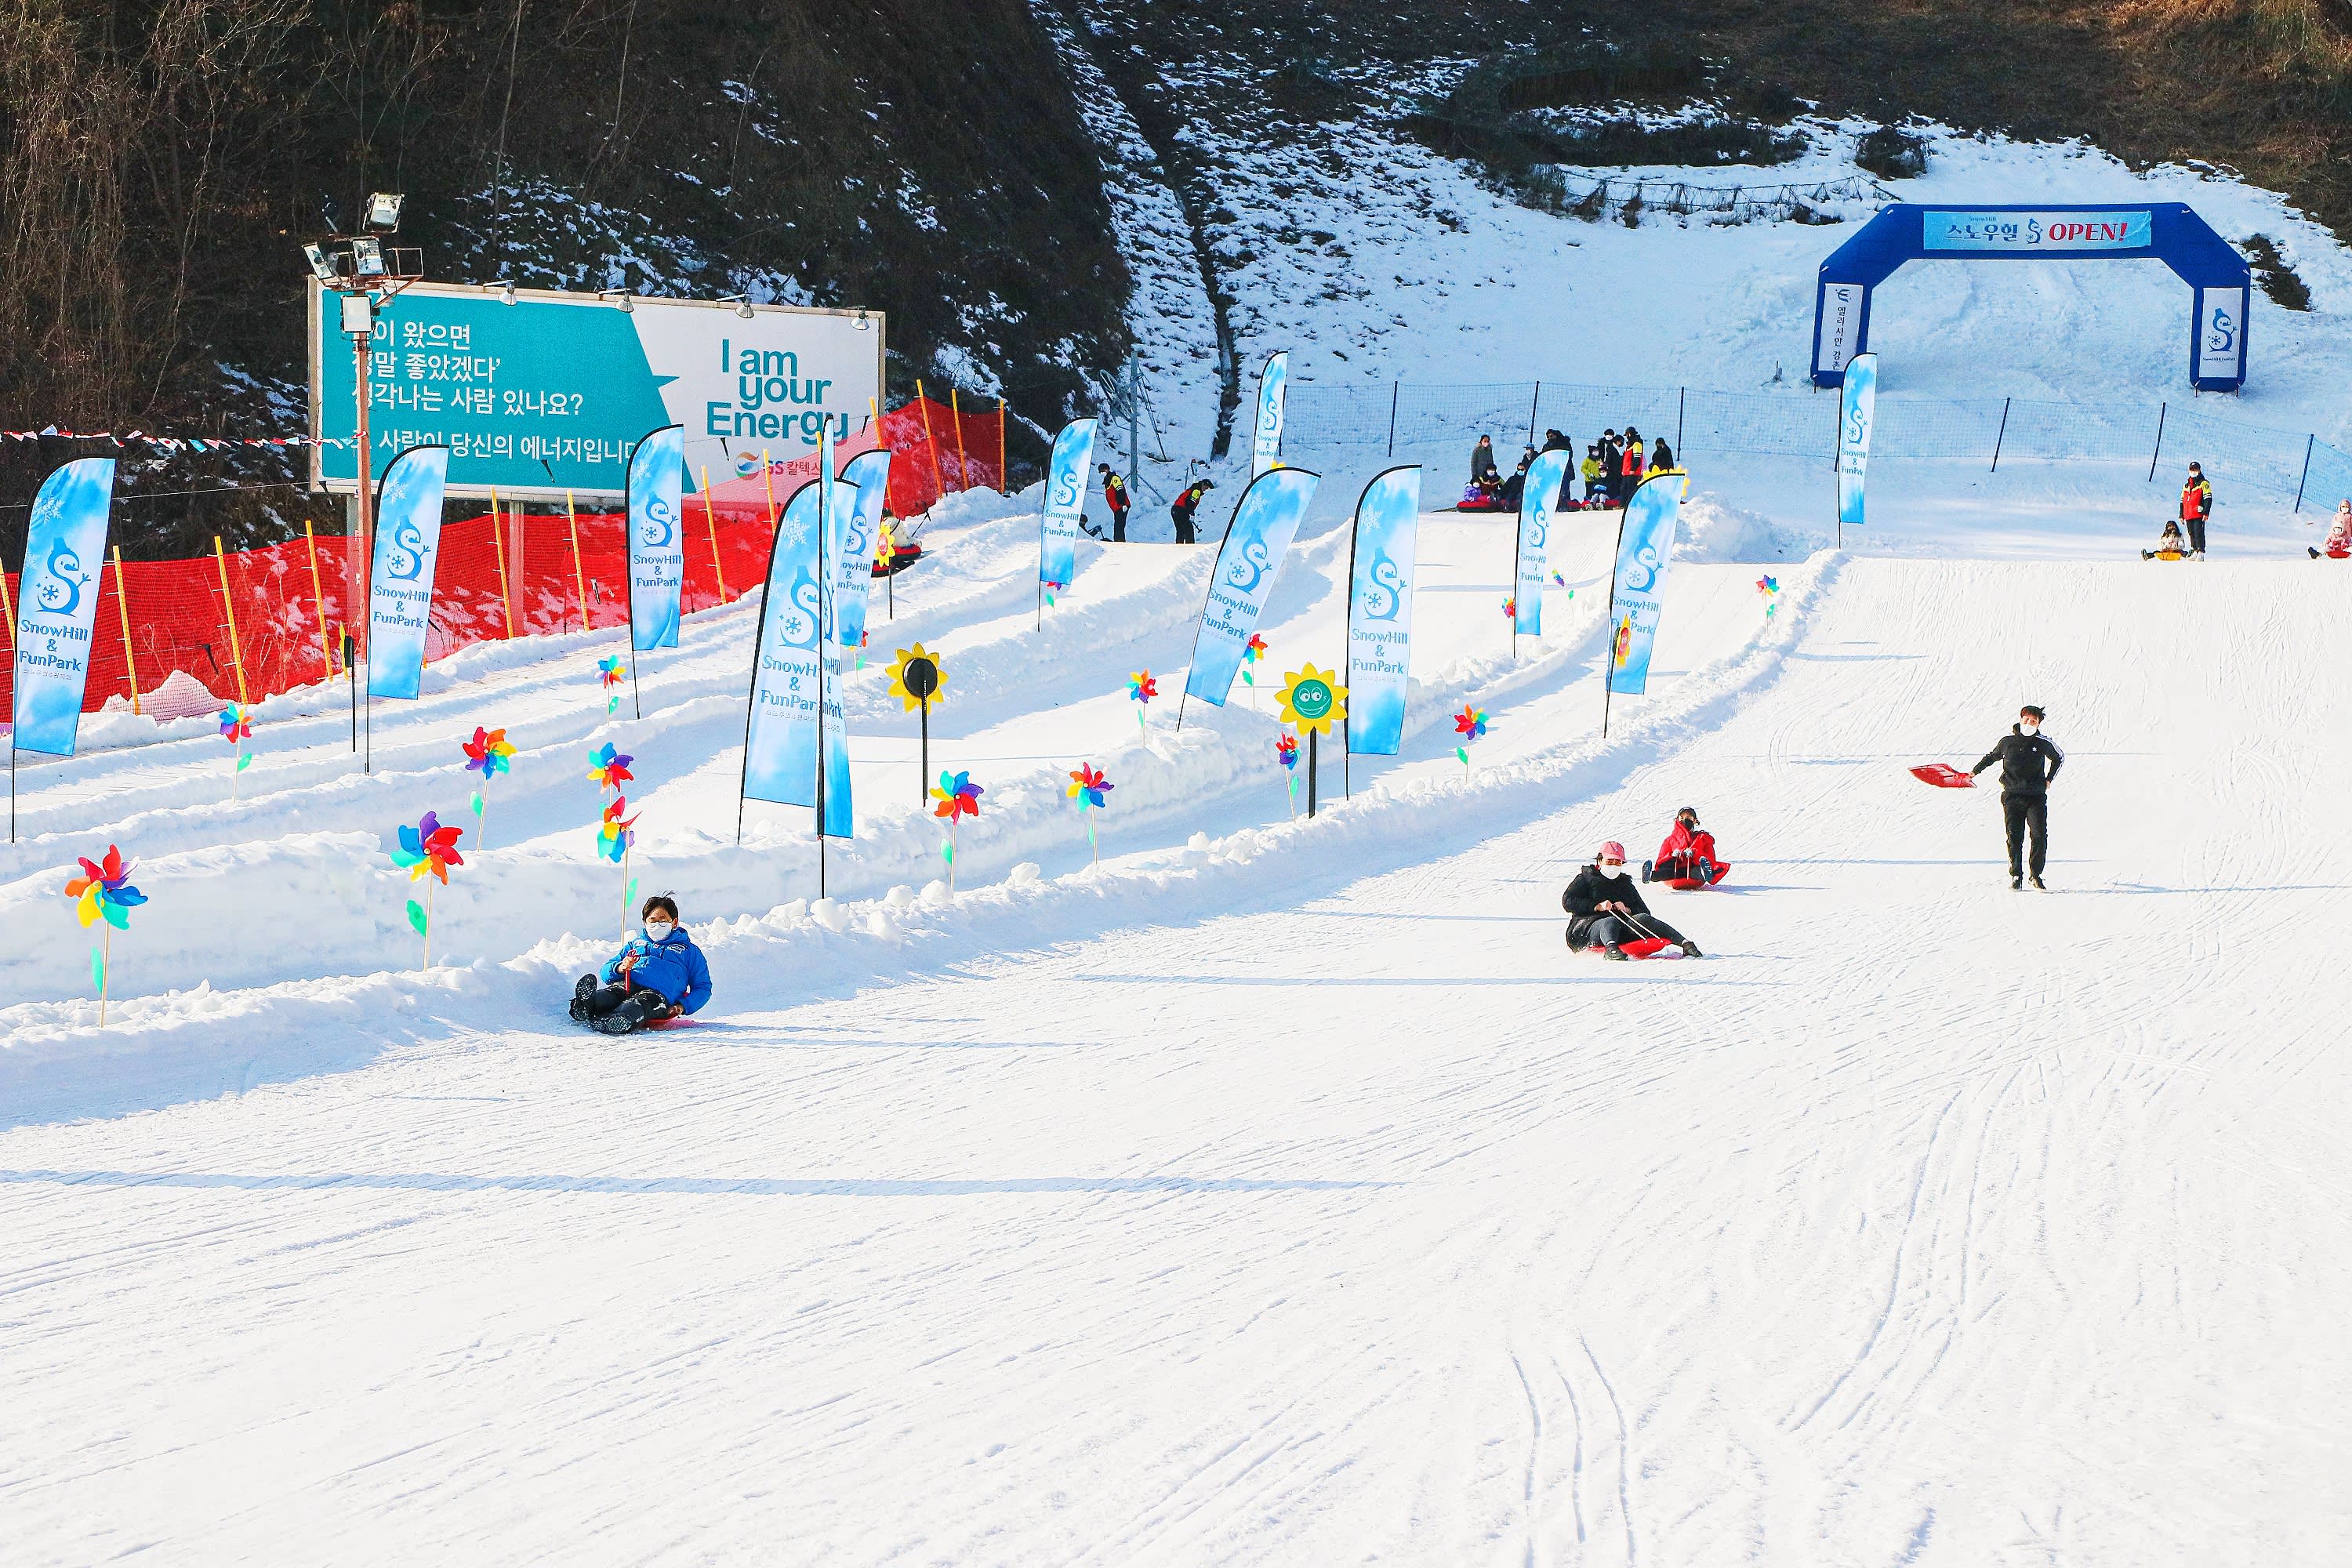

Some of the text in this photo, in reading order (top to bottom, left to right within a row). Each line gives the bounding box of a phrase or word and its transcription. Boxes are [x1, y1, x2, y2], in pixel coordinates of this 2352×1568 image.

[1946, 223, 2129, 242] 스노우힐 OPEN!
[1834, 307, 1846, 347] 엘리시안
[403, 321, 470, 350] 왔으면
[722, 339, 798, 377] I am
[739, 376, 833, 411] your
[451, 387, 496, 414] 사람
[503, 389, 583, 417] 있나요?
[379, 429, 442, 454] 사람이
[451, 432, 513, 459] 당신의
[787, 461, 821, 476] 칼텍스
[1045, 509, 1080, 521] SnowHill
[1044, 526, 1075, 538] FunPark
[633, 554, 681, 564] SnowHill
[842, 561, 871, 572] owHill
[654, 565, 662, 575] &
[845, 570, 852, 579] &
[636, 577, 679, 587] FunPark
[837, 581, 866, 593] nPark
[373, 585, 429, 603] SnowHill
[395, 601, 405, 612] &
[1208, 588, 1259, 617] SnowHill
[1613, 596, 1659, 612] SnowHill
[373, 611, 423, 629] FunPark
[1223, 608, 1232, 620] &
[1631, 610, 1638, 620] &
[20, 619, 89, 641] SnowHill
[1351, 628, 1408, 644] SnowHill
[46, 638, 57, 652] &
[1374, 644, 1385, 657] &
[19, 650, 82, 672] FunPark
[761, 655, 820, 677] SnowH
[1352, 658, 1404, 674] FunPark
[789, 677, 800, 691] &
[760, 689, 817, 711] FunPar
